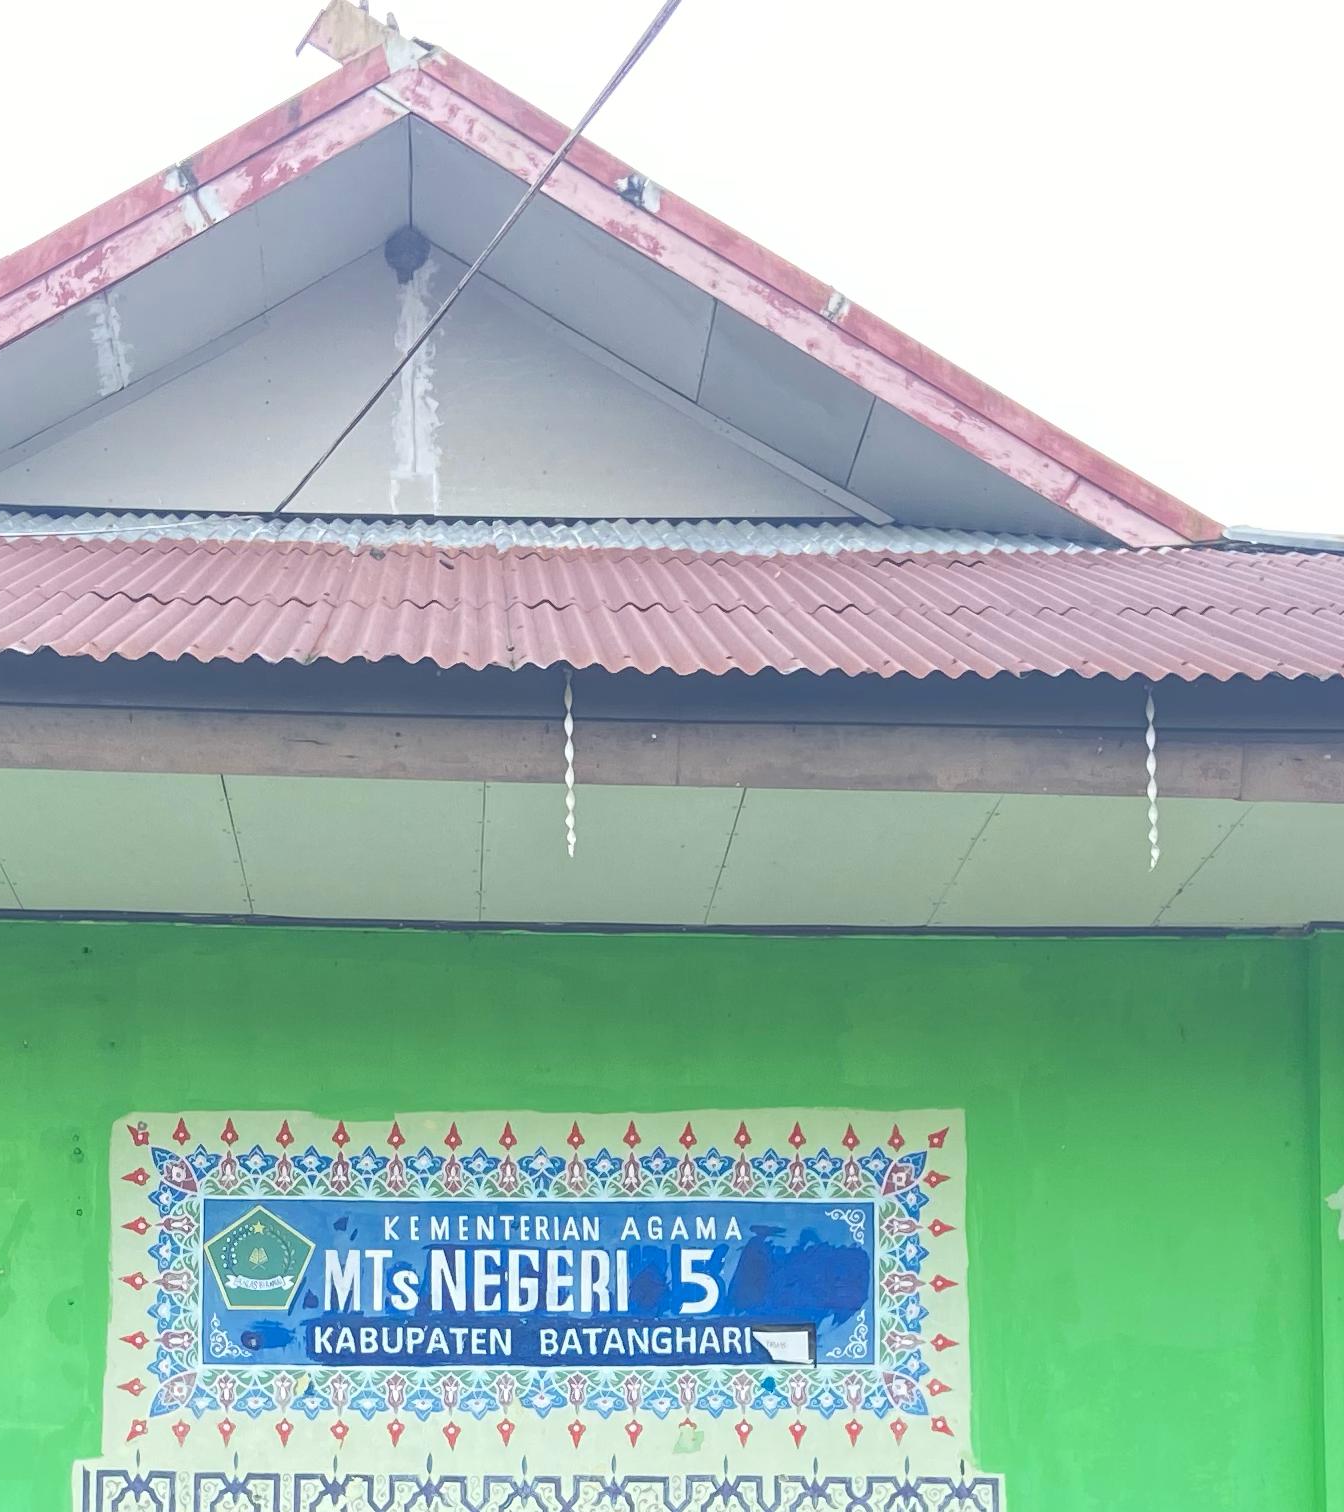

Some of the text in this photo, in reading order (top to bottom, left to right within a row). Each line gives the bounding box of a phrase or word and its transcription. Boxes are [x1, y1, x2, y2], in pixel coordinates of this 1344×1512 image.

[383, 1215, 743, 1242] KEMENTERIAN AGAMA
[323, 1248, 719, 1314] MTs NEGERI 5
[314, 1325, 752, 1357] KABUPATEN BATANGHARI
